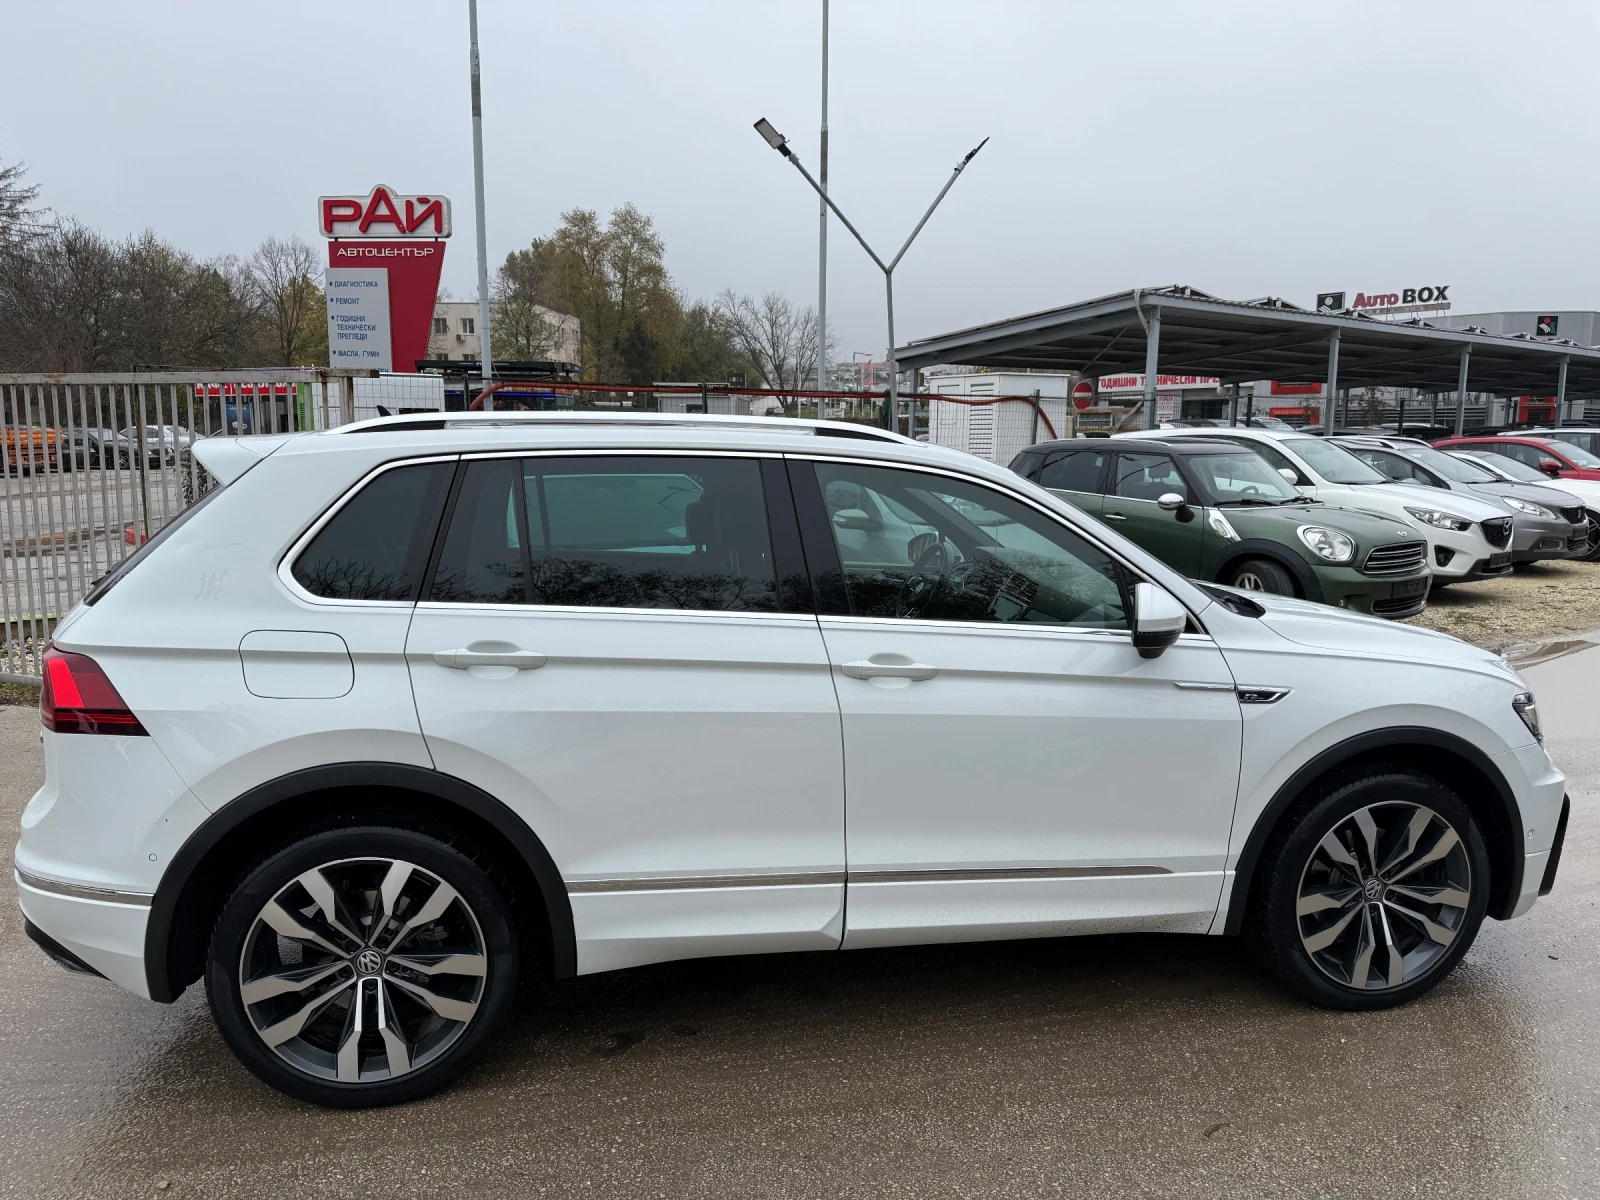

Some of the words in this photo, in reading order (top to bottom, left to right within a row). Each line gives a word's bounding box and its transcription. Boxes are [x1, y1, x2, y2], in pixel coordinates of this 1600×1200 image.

[323, 187, 442, 233] РАЙ
[336, 247, 435, 257] АВТОЦЕНТЪР
[1402, 286, 1450, 304] BOX
[335, 297, 360, 305] РЕМОНТ
[336, 315, 366, 323] ГОДИШНИ
[336, 324, 377, 332] ТЕХНИЧЕСКИ
[337, 332, 368, 341] ПРЕГЛЕДИ
[338, 350, 361, 358] МАСЛА,
[362, 350, 380, 358] ГУМИ
[1099, 377, 1137, 389] ОДИШНИ
